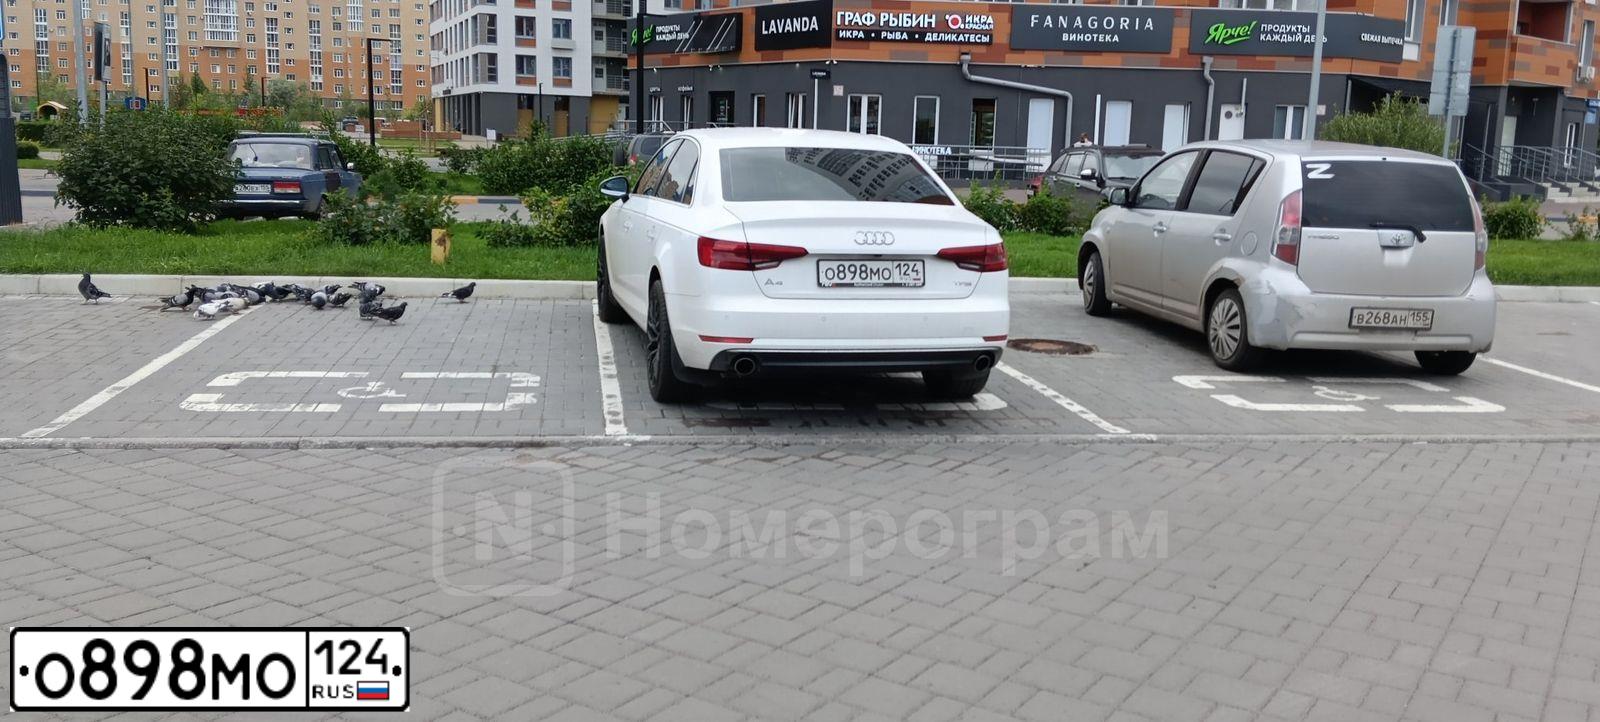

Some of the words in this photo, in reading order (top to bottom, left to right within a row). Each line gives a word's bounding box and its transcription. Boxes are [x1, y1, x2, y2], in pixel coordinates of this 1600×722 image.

[836, 11, 876, 27] ГРАФ
[880, 12, 936, 28] РЫБИН
[965, 14, 994, 24] ИКРА
[1030, 14, 1154, 31] FANAGORIA
[655, 24, 681, 33] ПРОДУКТЫ
[762, 16, 819, 35] LAVANDA
[1260, 24, 1311, 34] ПРОДУКТЫ
[655, 32, 677, 41] КАЖДЫЙ
[839, 30, 865, 39] ИКРА
[881, 31, 909, 40] РЫБА
[924, 32, 990, 43] ДЕЛИКАТЕСЫ
[1062, 33, 1120, 43] ВИНОТЕКА
[1204, 20, 1258, 45] Ярче!
[1260, 32, 1303, 43] КАЖДЫЙ
[1304, 34, 1328, 44] ДЕЬ
[1361, 33, 1381, 43] СВЕЖАЯ
[1306, 163, 1335, 179] Z
[895, 262, 920, 276] 124
[1410, 311, 1429, 322] 155
